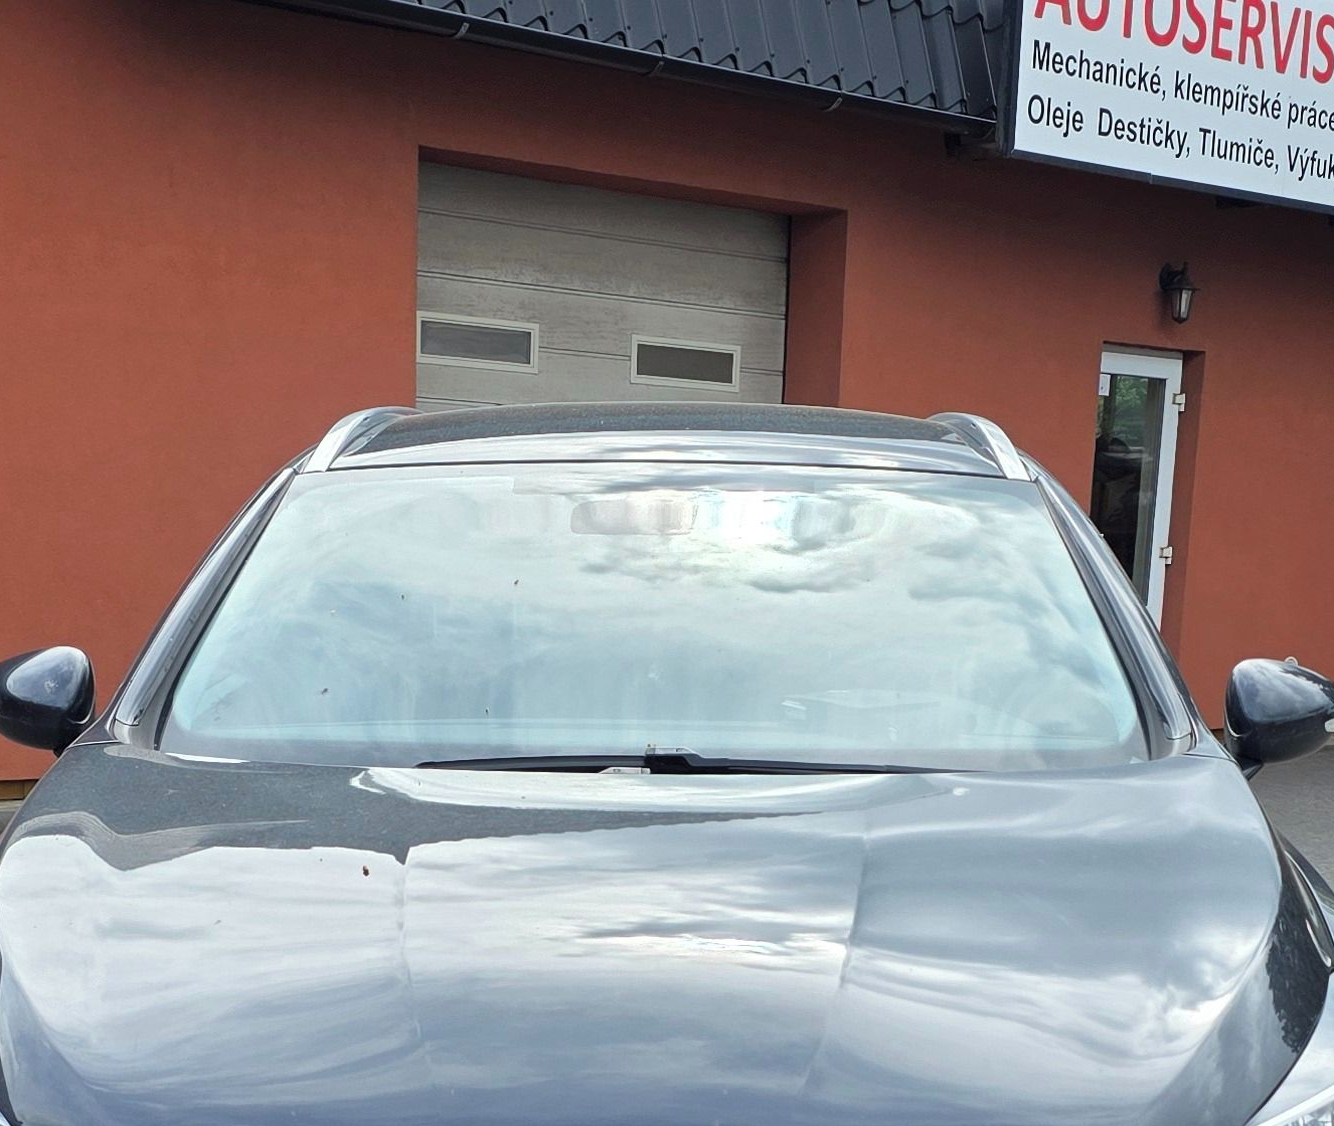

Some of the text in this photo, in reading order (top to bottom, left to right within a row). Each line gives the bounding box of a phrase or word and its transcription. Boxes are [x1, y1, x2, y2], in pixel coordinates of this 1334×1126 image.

[1032, 39, 1167, 101] Mechanické,
[1174, 70, 1282, 119] klempířské
[1027, 94, 1084, 137] Oleje
[1098, 107, 1190, 159] Destičky,
[1198, 127, 1279, 174] Tlumiče,
